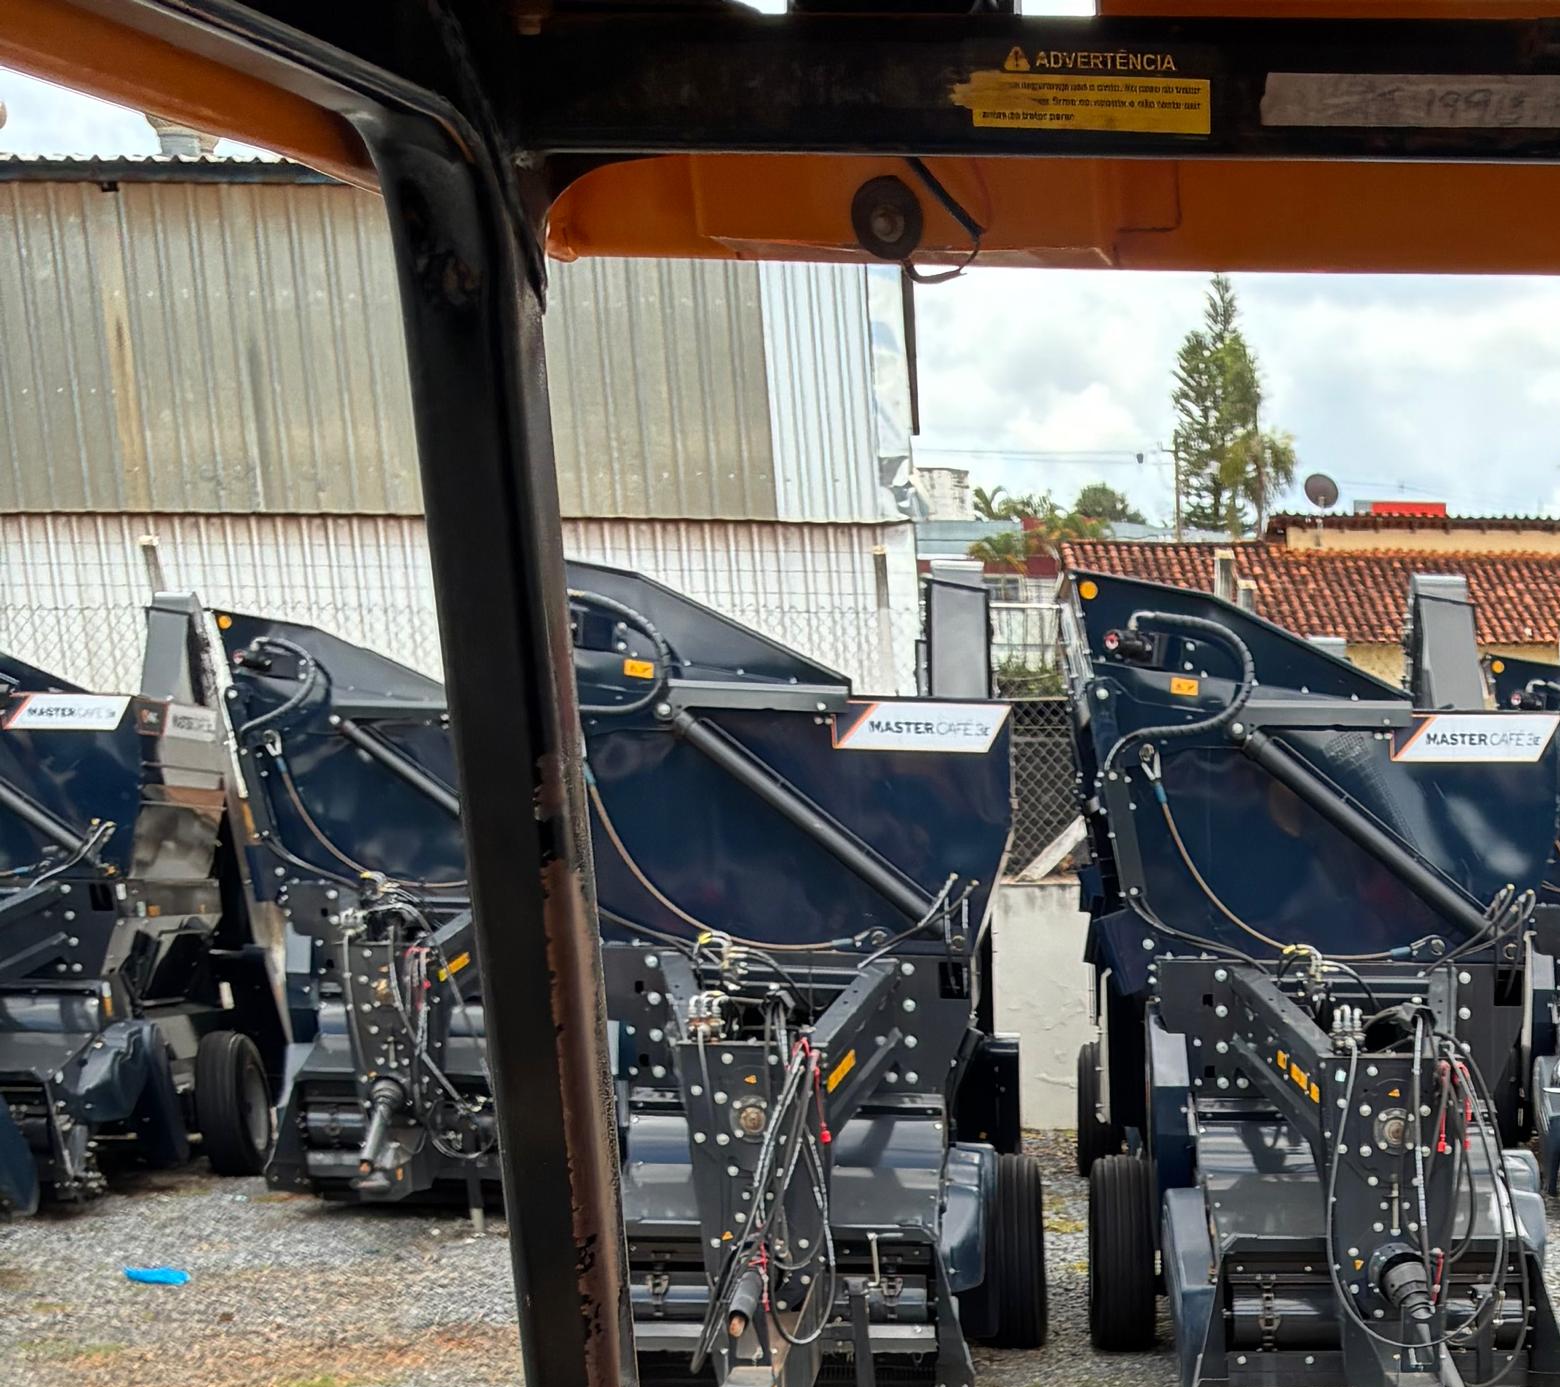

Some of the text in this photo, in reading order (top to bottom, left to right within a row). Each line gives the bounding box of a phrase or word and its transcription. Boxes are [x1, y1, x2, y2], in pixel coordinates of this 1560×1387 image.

[1036, 49, 1176, 71] ADVERTÊNCIA
[869, 720, 934, 734] MASTER
[1426, 732, 1488, 746] MASTER
